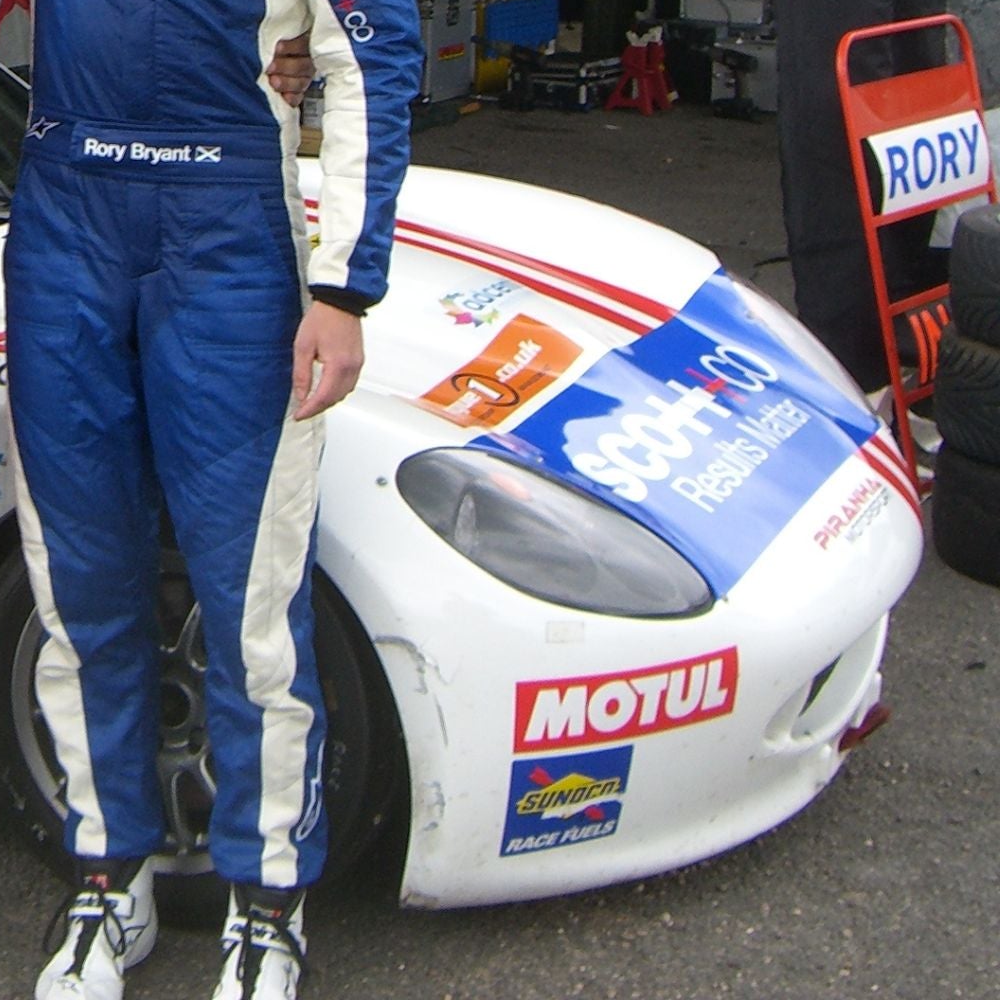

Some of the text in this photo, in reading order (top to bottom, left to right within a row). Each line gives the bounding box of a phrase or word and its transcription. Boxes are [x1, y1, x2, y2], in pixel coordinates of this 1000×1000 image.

[83, 136, 192, 163] Rory Bryant
[885, 123, 979, 199] RORY
[670, 398, 812, 513] Results Matter
[813, 477, 883, 551] PIRANHA
[522, 657, 729, 743] MOTUL
[520, 778, 622, 812] SUNOCO
[505, 820, 616, 853] RACE FUELS
